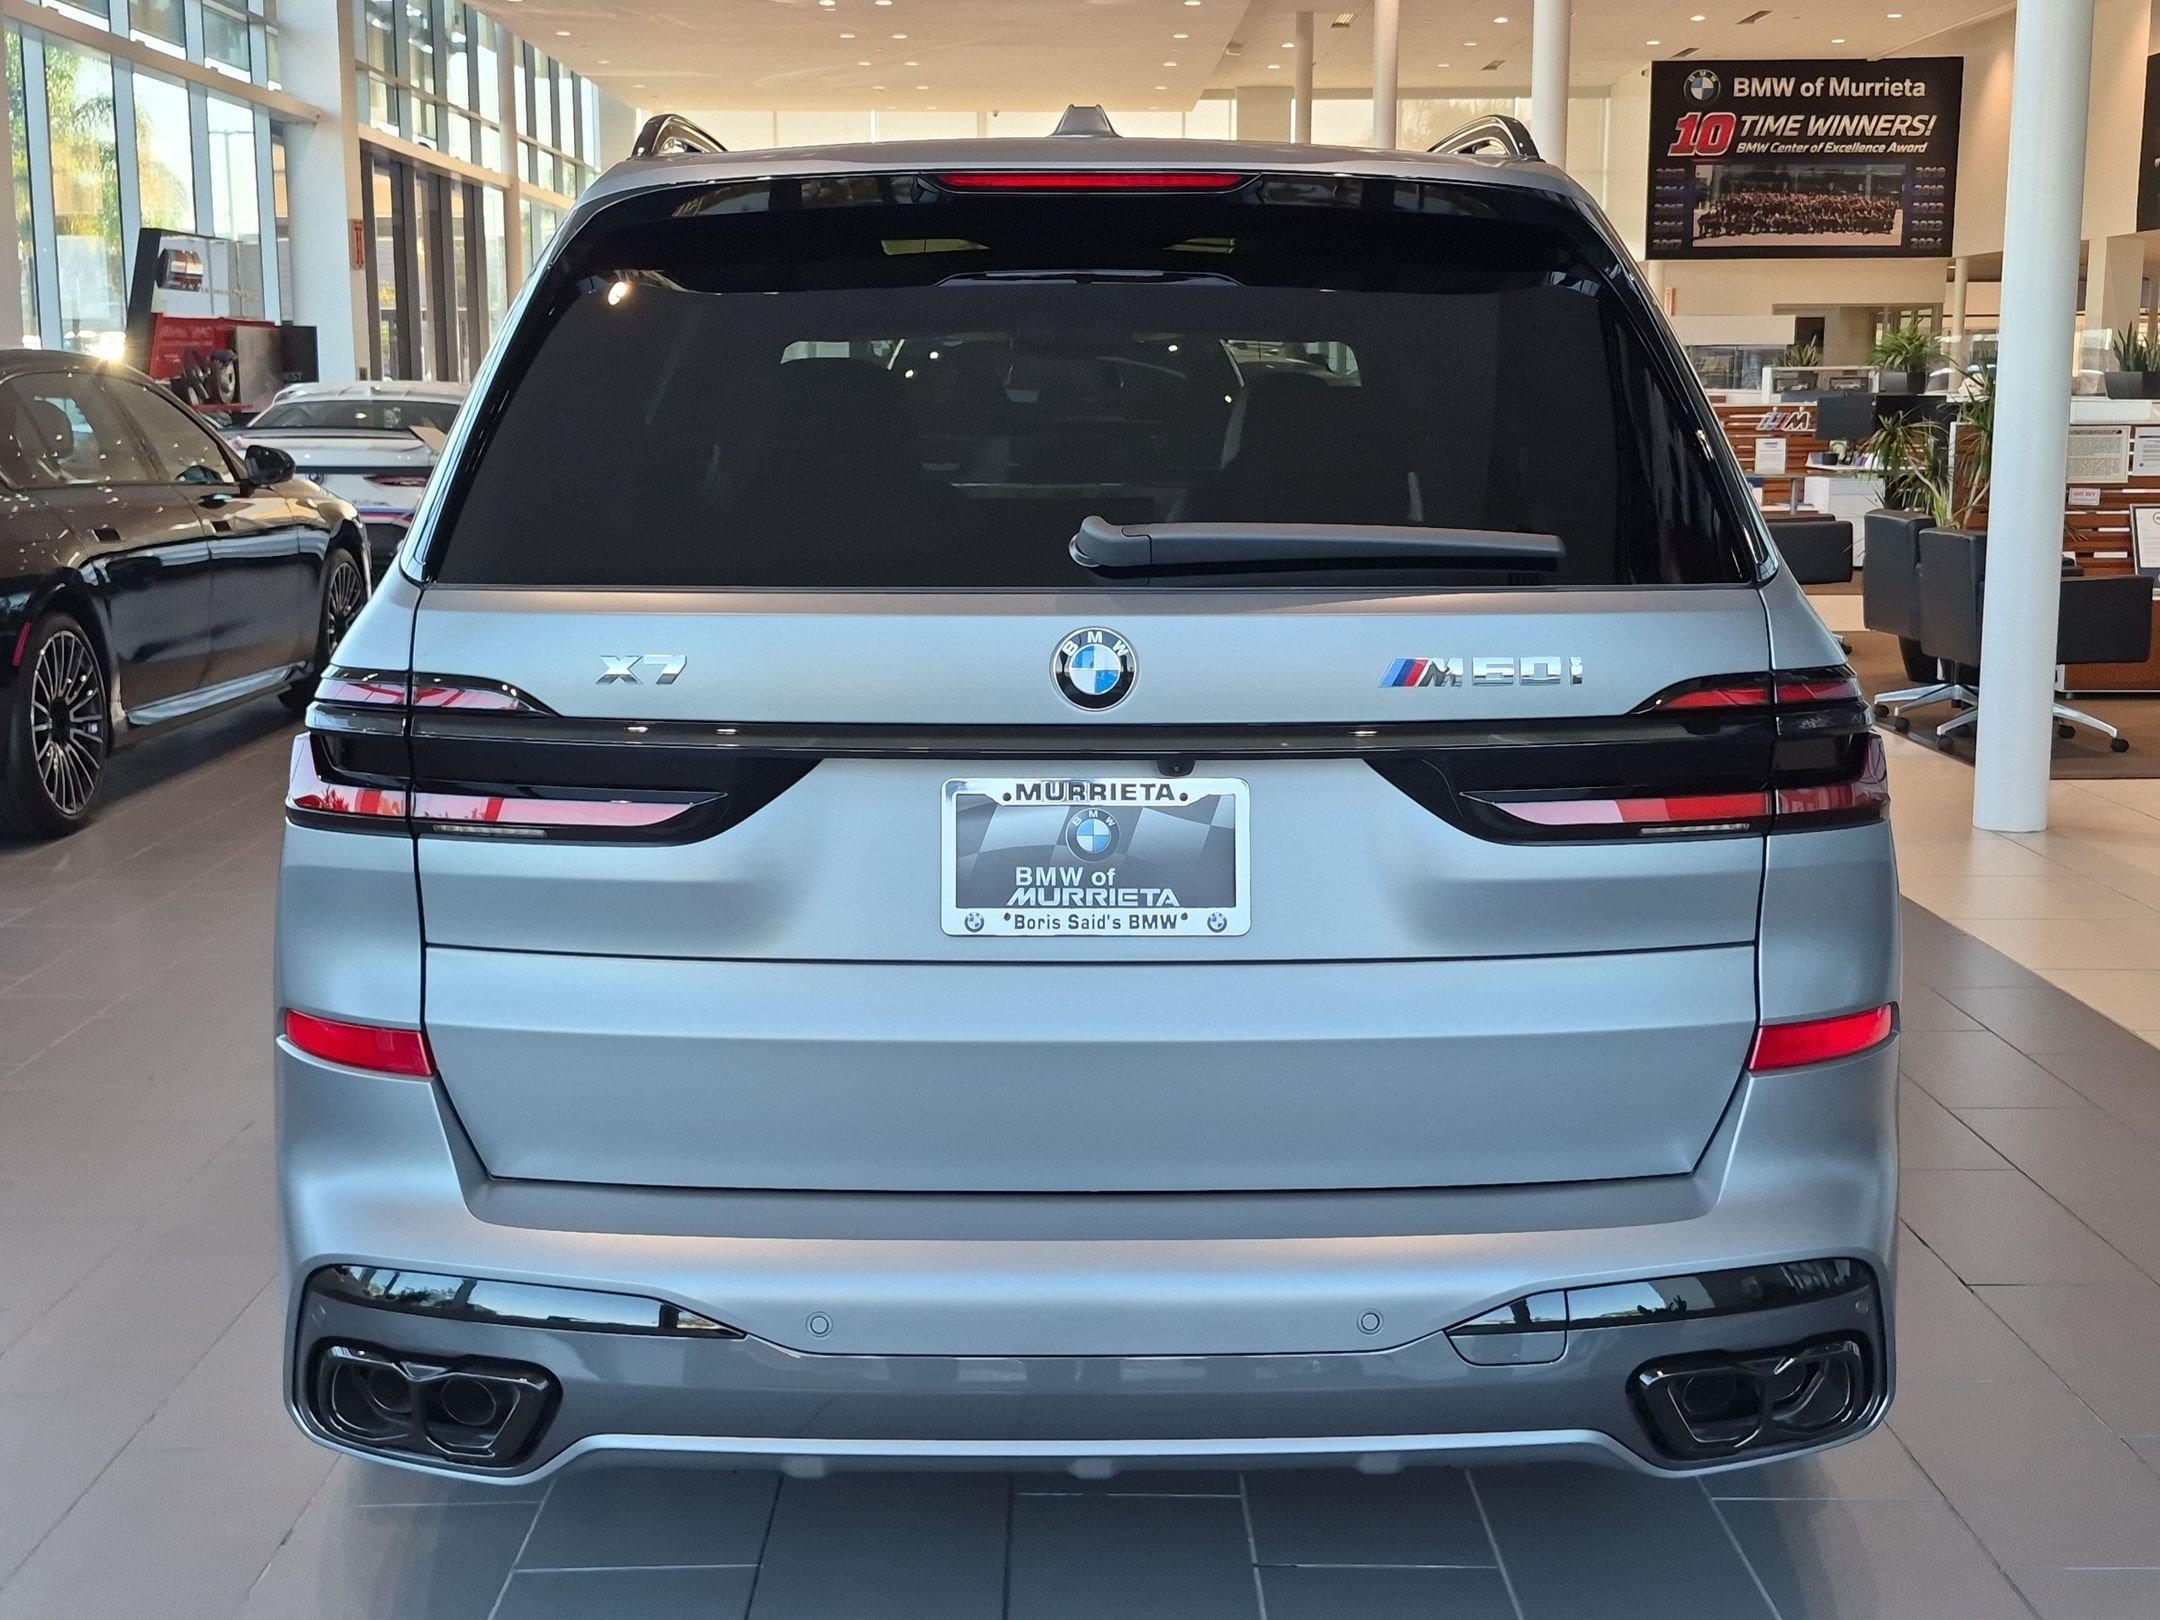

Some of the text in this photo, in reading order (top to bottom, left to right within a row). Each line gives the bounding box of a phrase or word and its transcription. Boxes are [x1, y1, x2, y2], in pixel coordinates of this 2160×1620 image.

[1733, 77, 1926, 97] BMW of Murrieta
[1667, 111, 1938, 156] 10 TIME WINNERS!
[1736, 142, 1928, 153] BMW Center of Excellence Award
[1062, 631, 1129, 657] BMW
[595, 654, 687, 685] X7
[1409, 655, 1583, 688] M60i
[1015, 783, 1175, 802] MURRIETA
[1071, 810, 1116, 826] BMW
[1016, 867, 1116, 887] BMW of
[1006, 888, 1180, 907] MURRIETA
[1014, 914, 1177, 929] Boris Said's BMW
